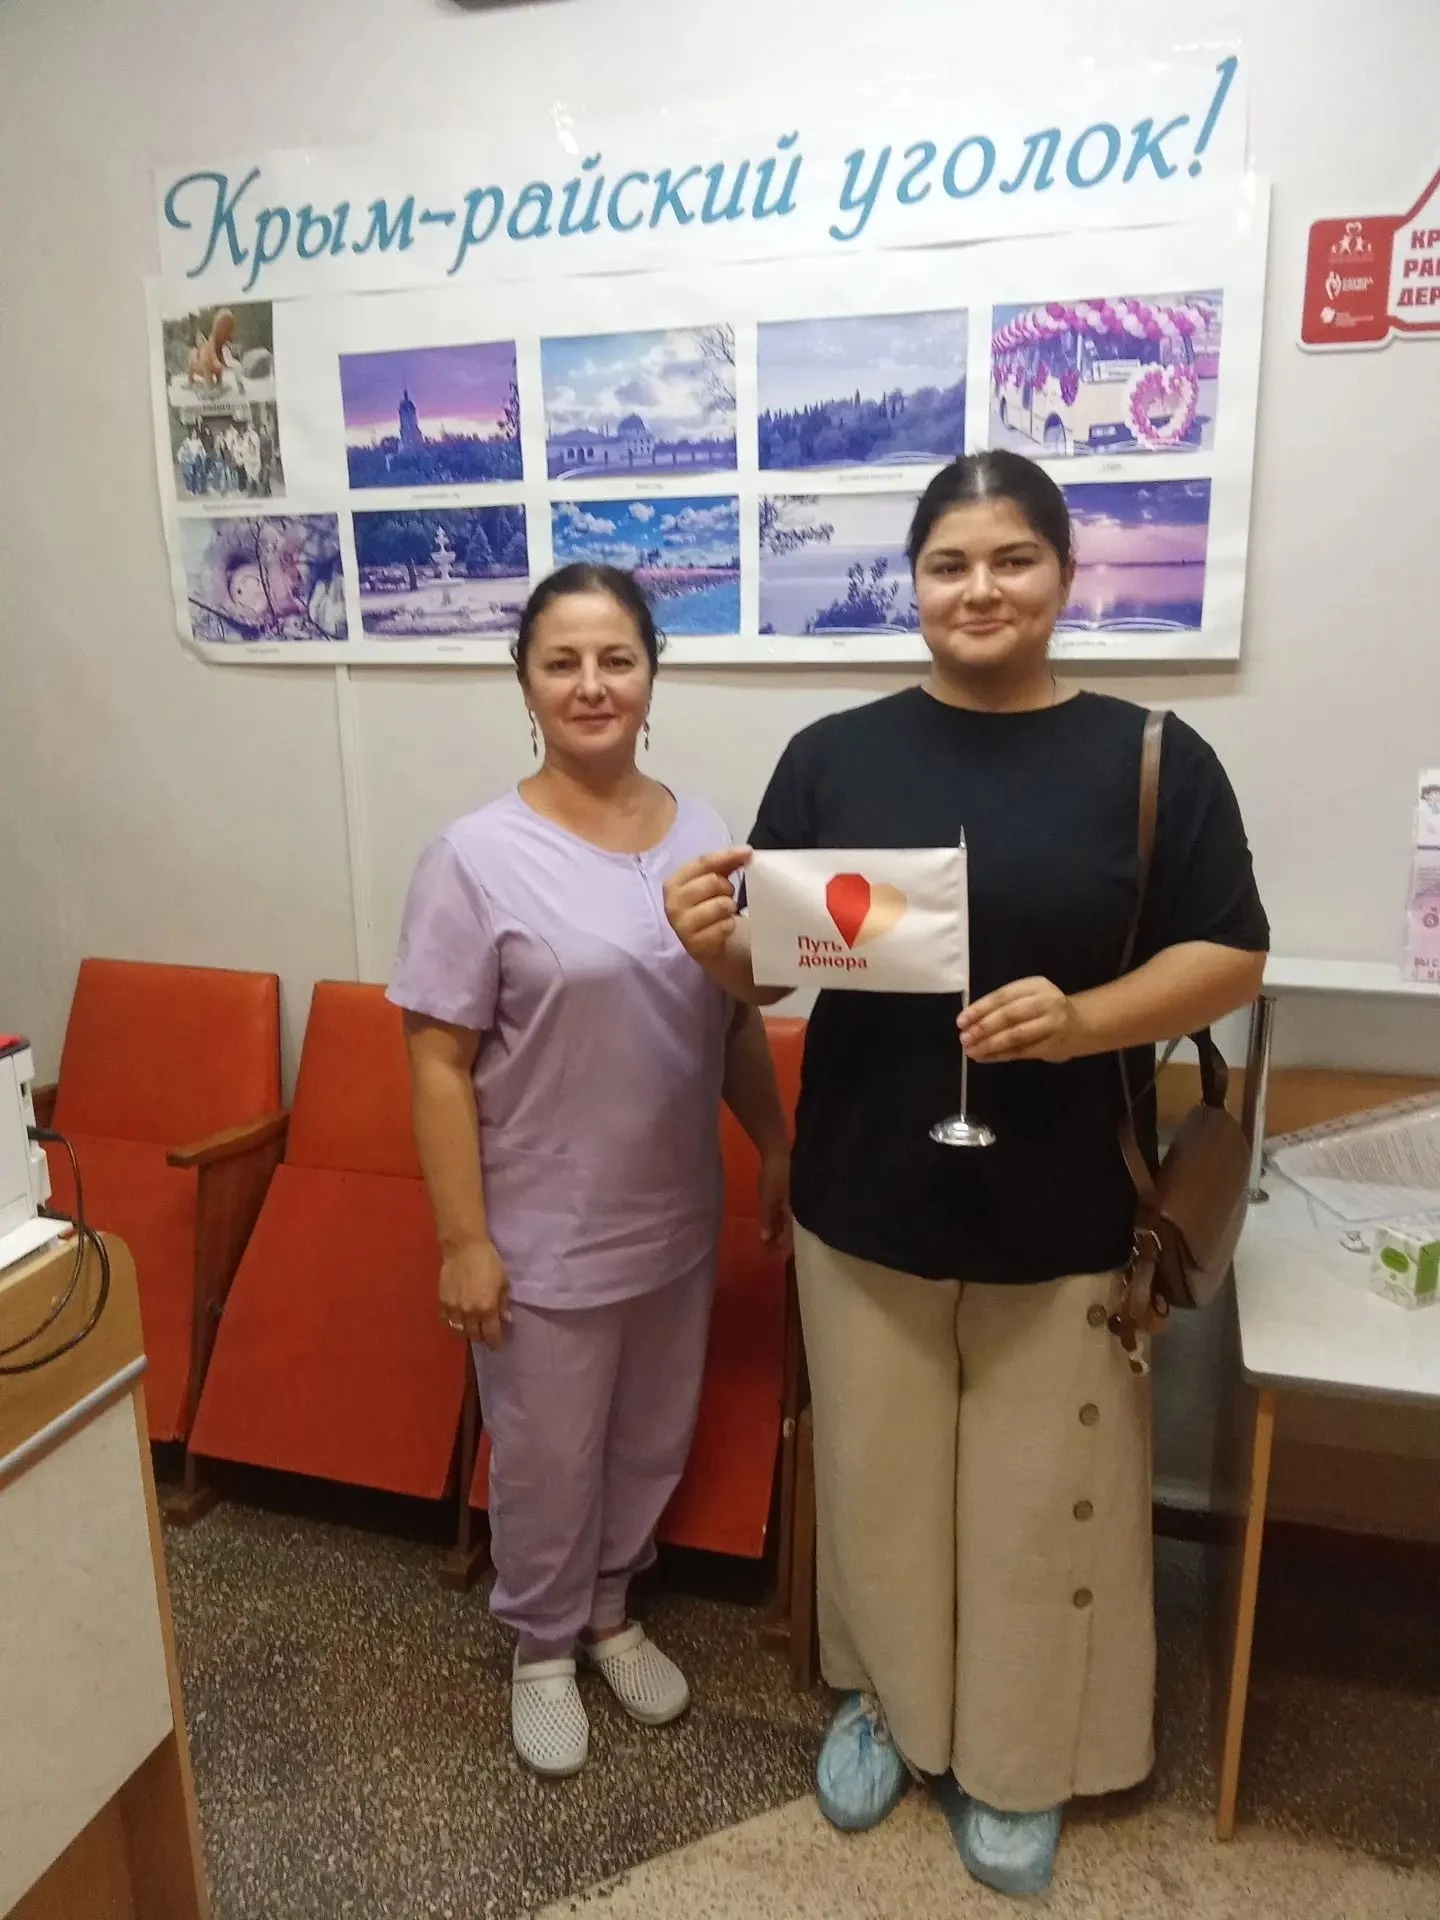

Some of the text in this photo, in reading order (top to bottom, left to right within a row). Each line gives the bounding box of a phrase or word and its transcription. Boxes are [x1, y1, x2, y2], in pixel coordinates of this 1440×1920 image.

[164, 54, 1239, 292] Крым-райский уголок!
[797, 935, 843, 954] Путь
[799, 954, 868, 973] донора
